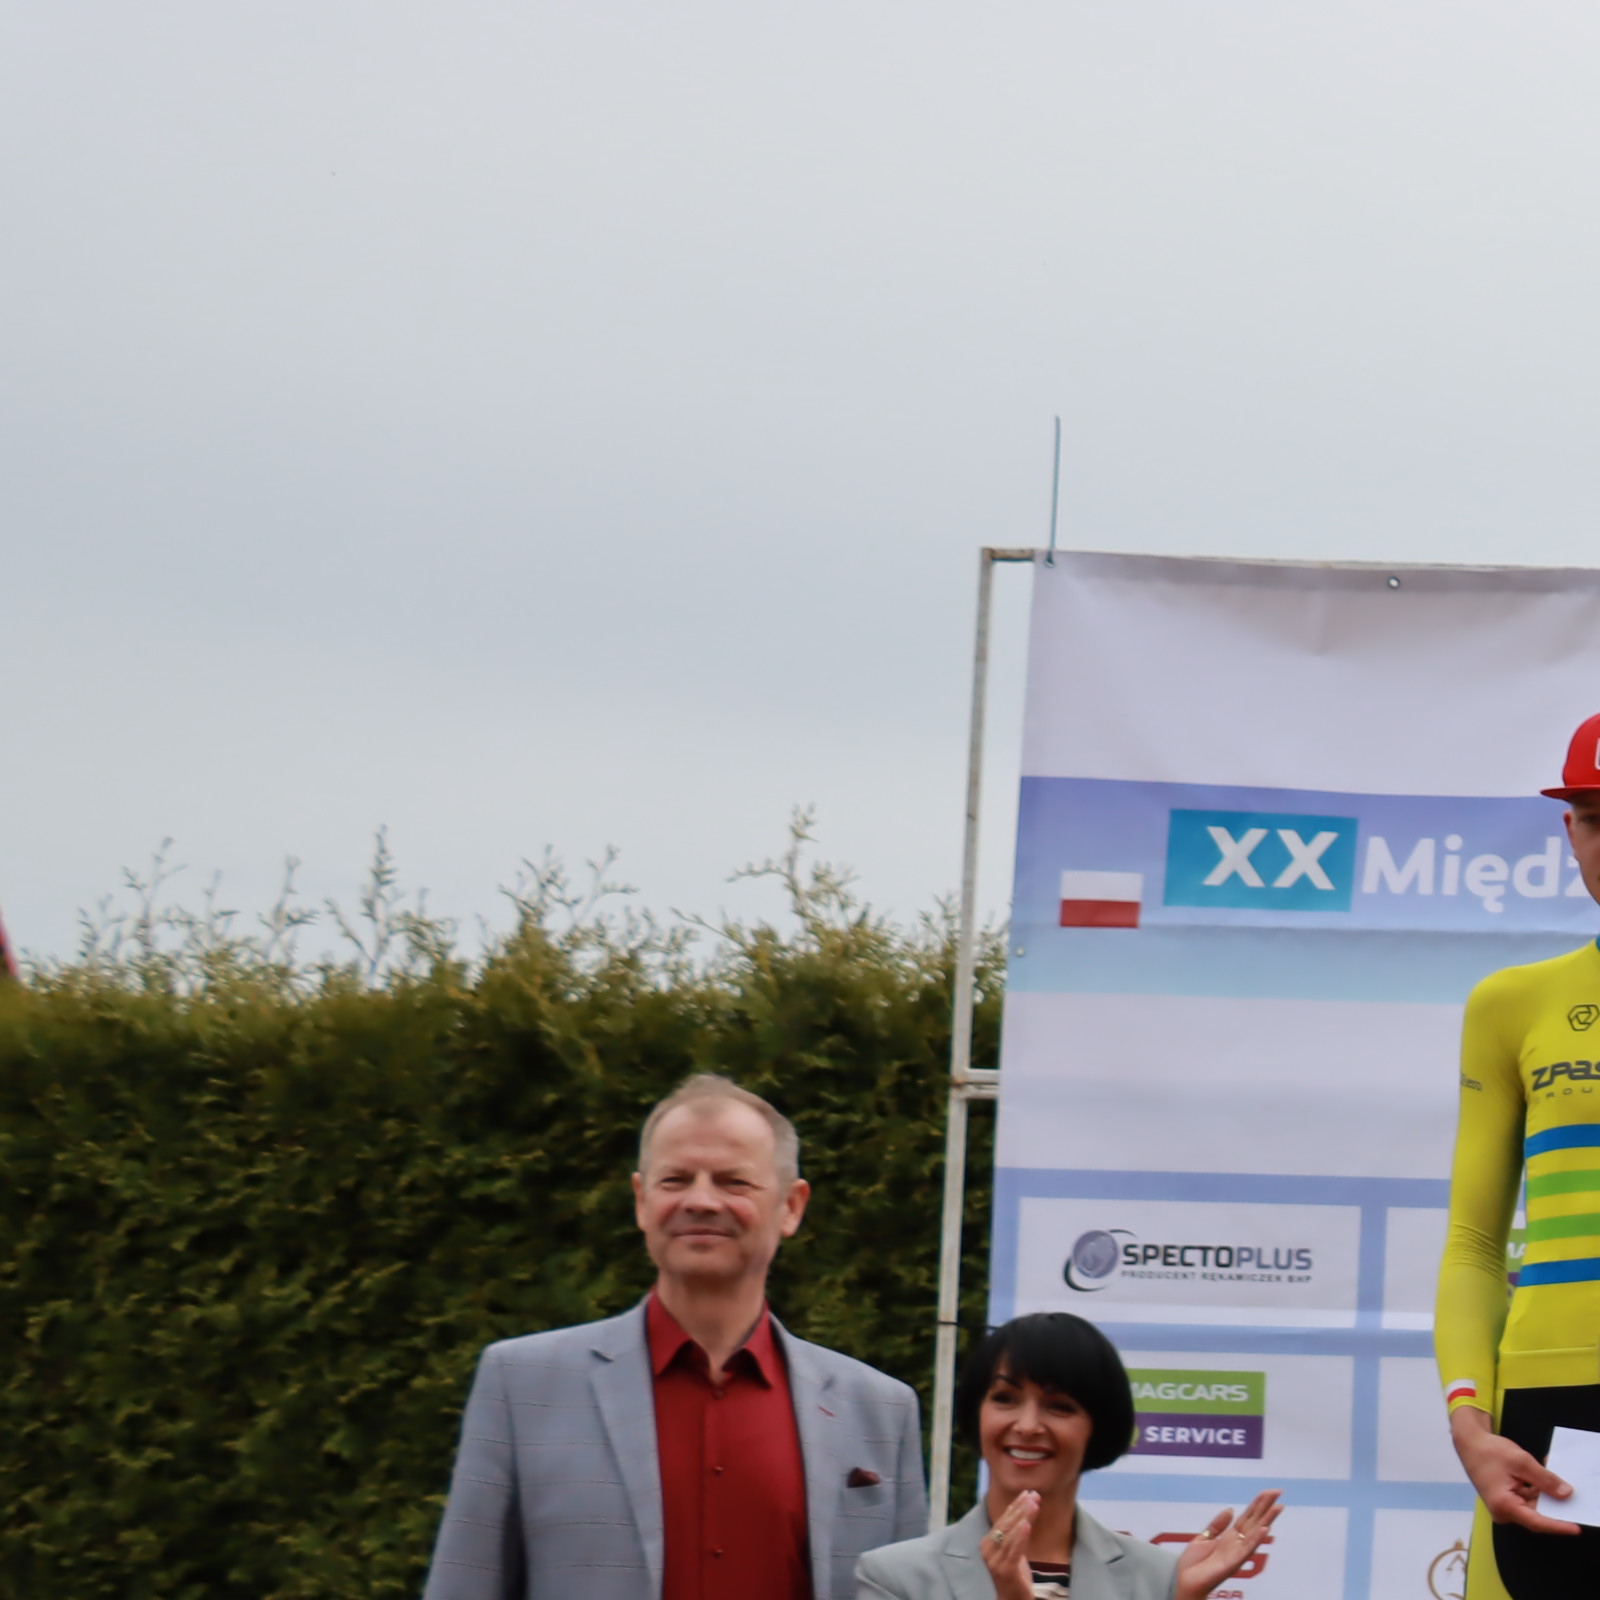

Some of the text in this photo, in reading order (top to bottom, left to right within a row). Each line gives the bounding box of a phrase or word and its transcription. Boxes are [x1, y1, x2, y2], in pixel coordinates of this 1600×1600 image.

[1201, 825, 1339, 892] XX
[1122, 1244, 1313, 1270] SPECTOPLUS
[1144, 1425, 1246, 1446] SERVICE
